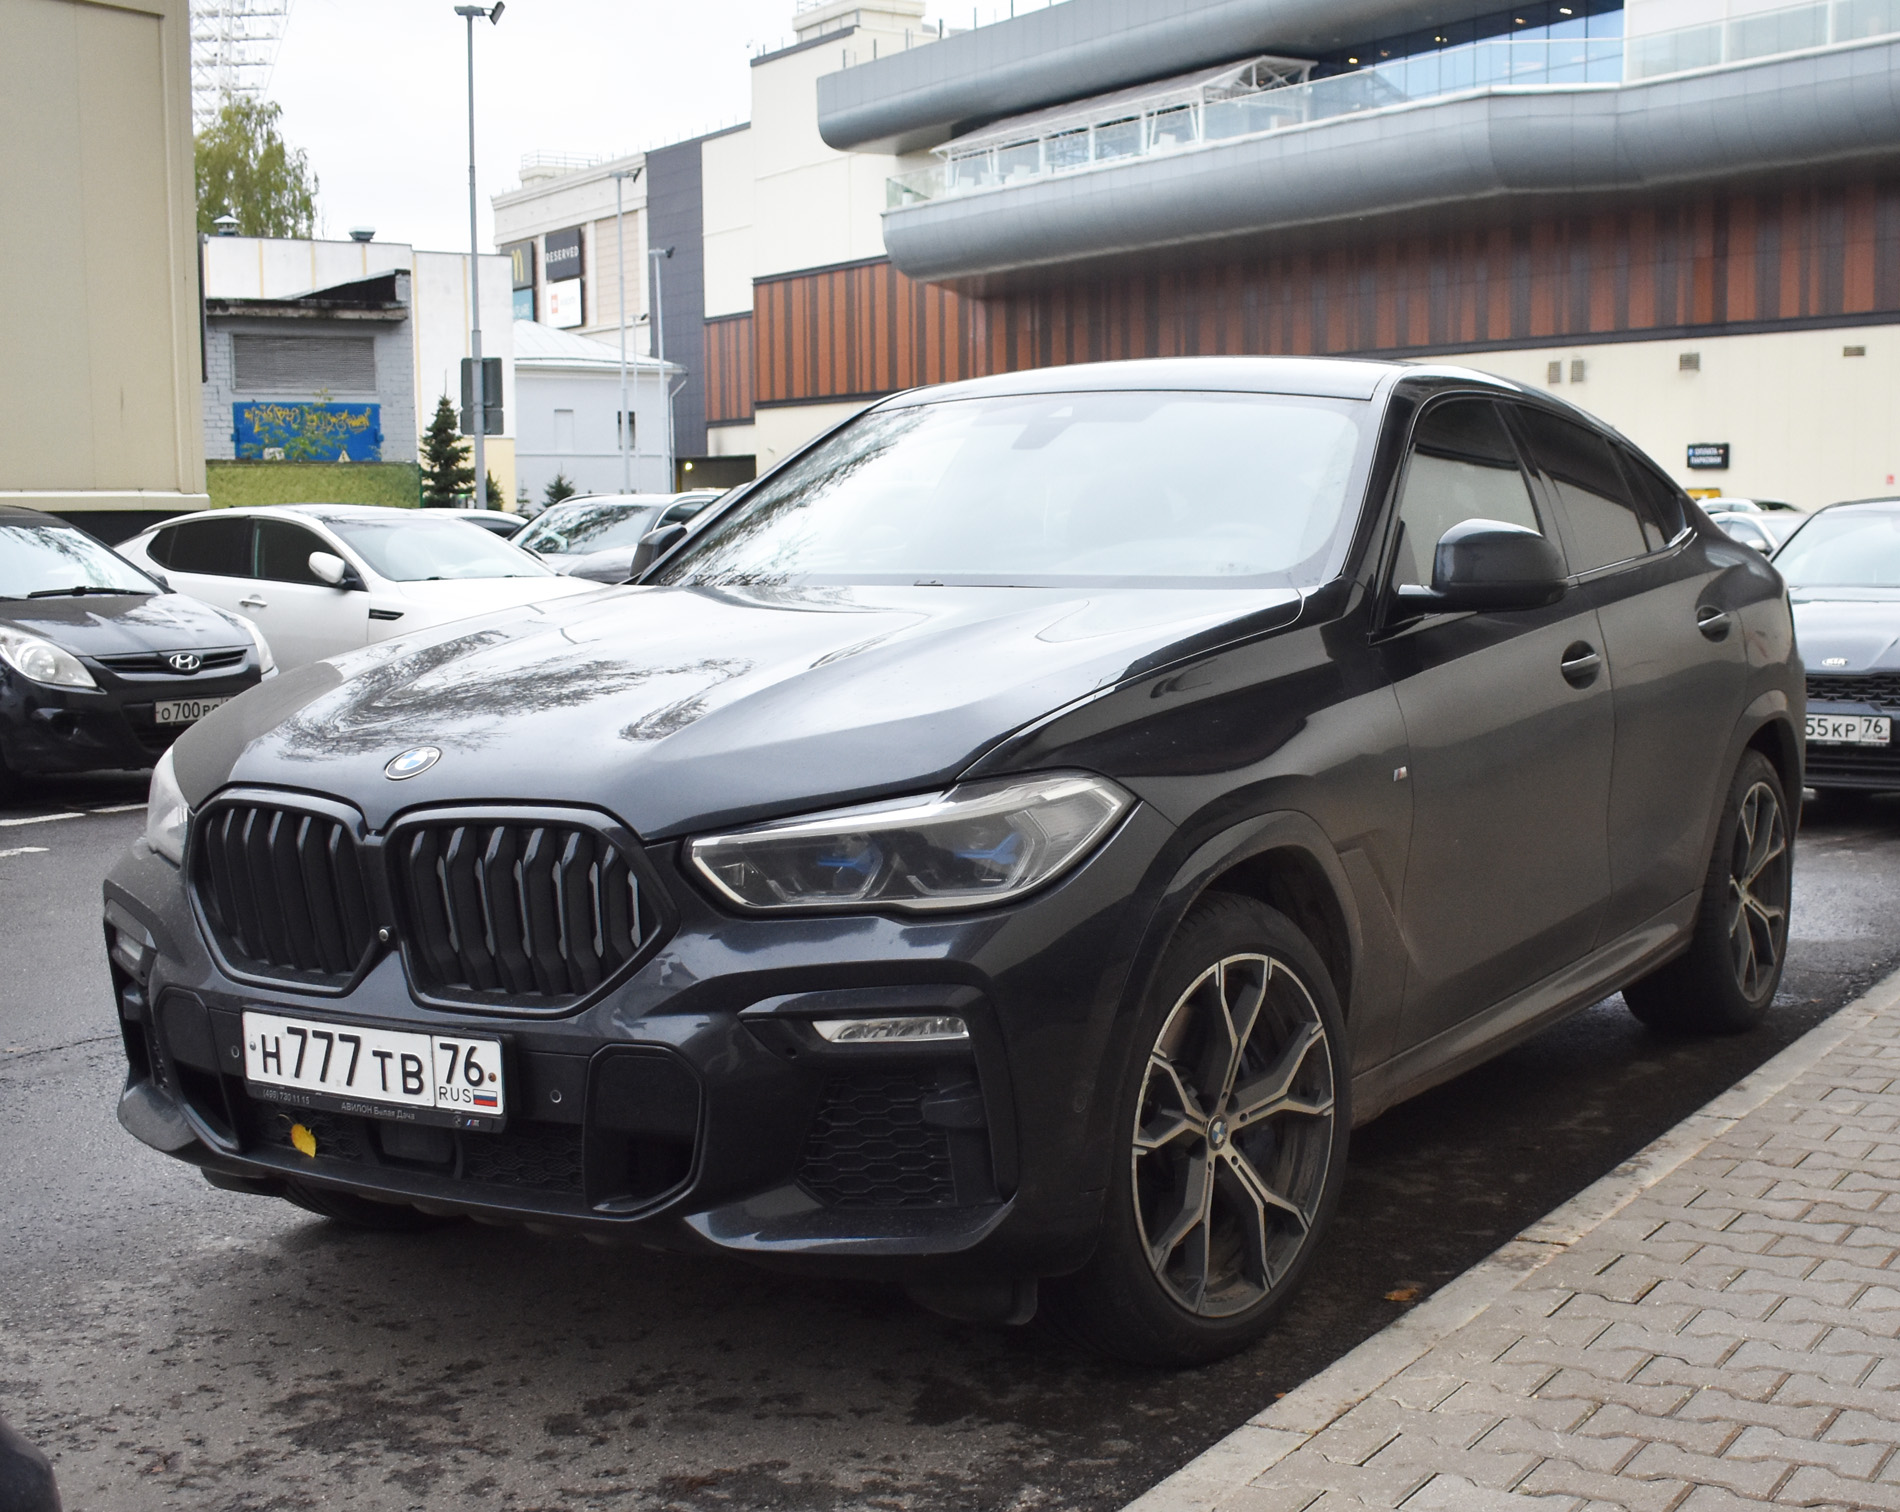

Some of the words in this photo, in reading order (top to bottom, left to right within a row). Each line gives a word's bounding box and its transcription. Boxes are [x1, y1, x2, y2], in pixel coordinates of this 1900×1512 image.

[545, 245, 579, 263] RESERVED
[1863, 718, 1883, 734] 76
[439, 1042, 485, 1087] 76
[438, 1086, 472, 1104] RUS
[341, 1102, 373, 1114] АВИЛОН
